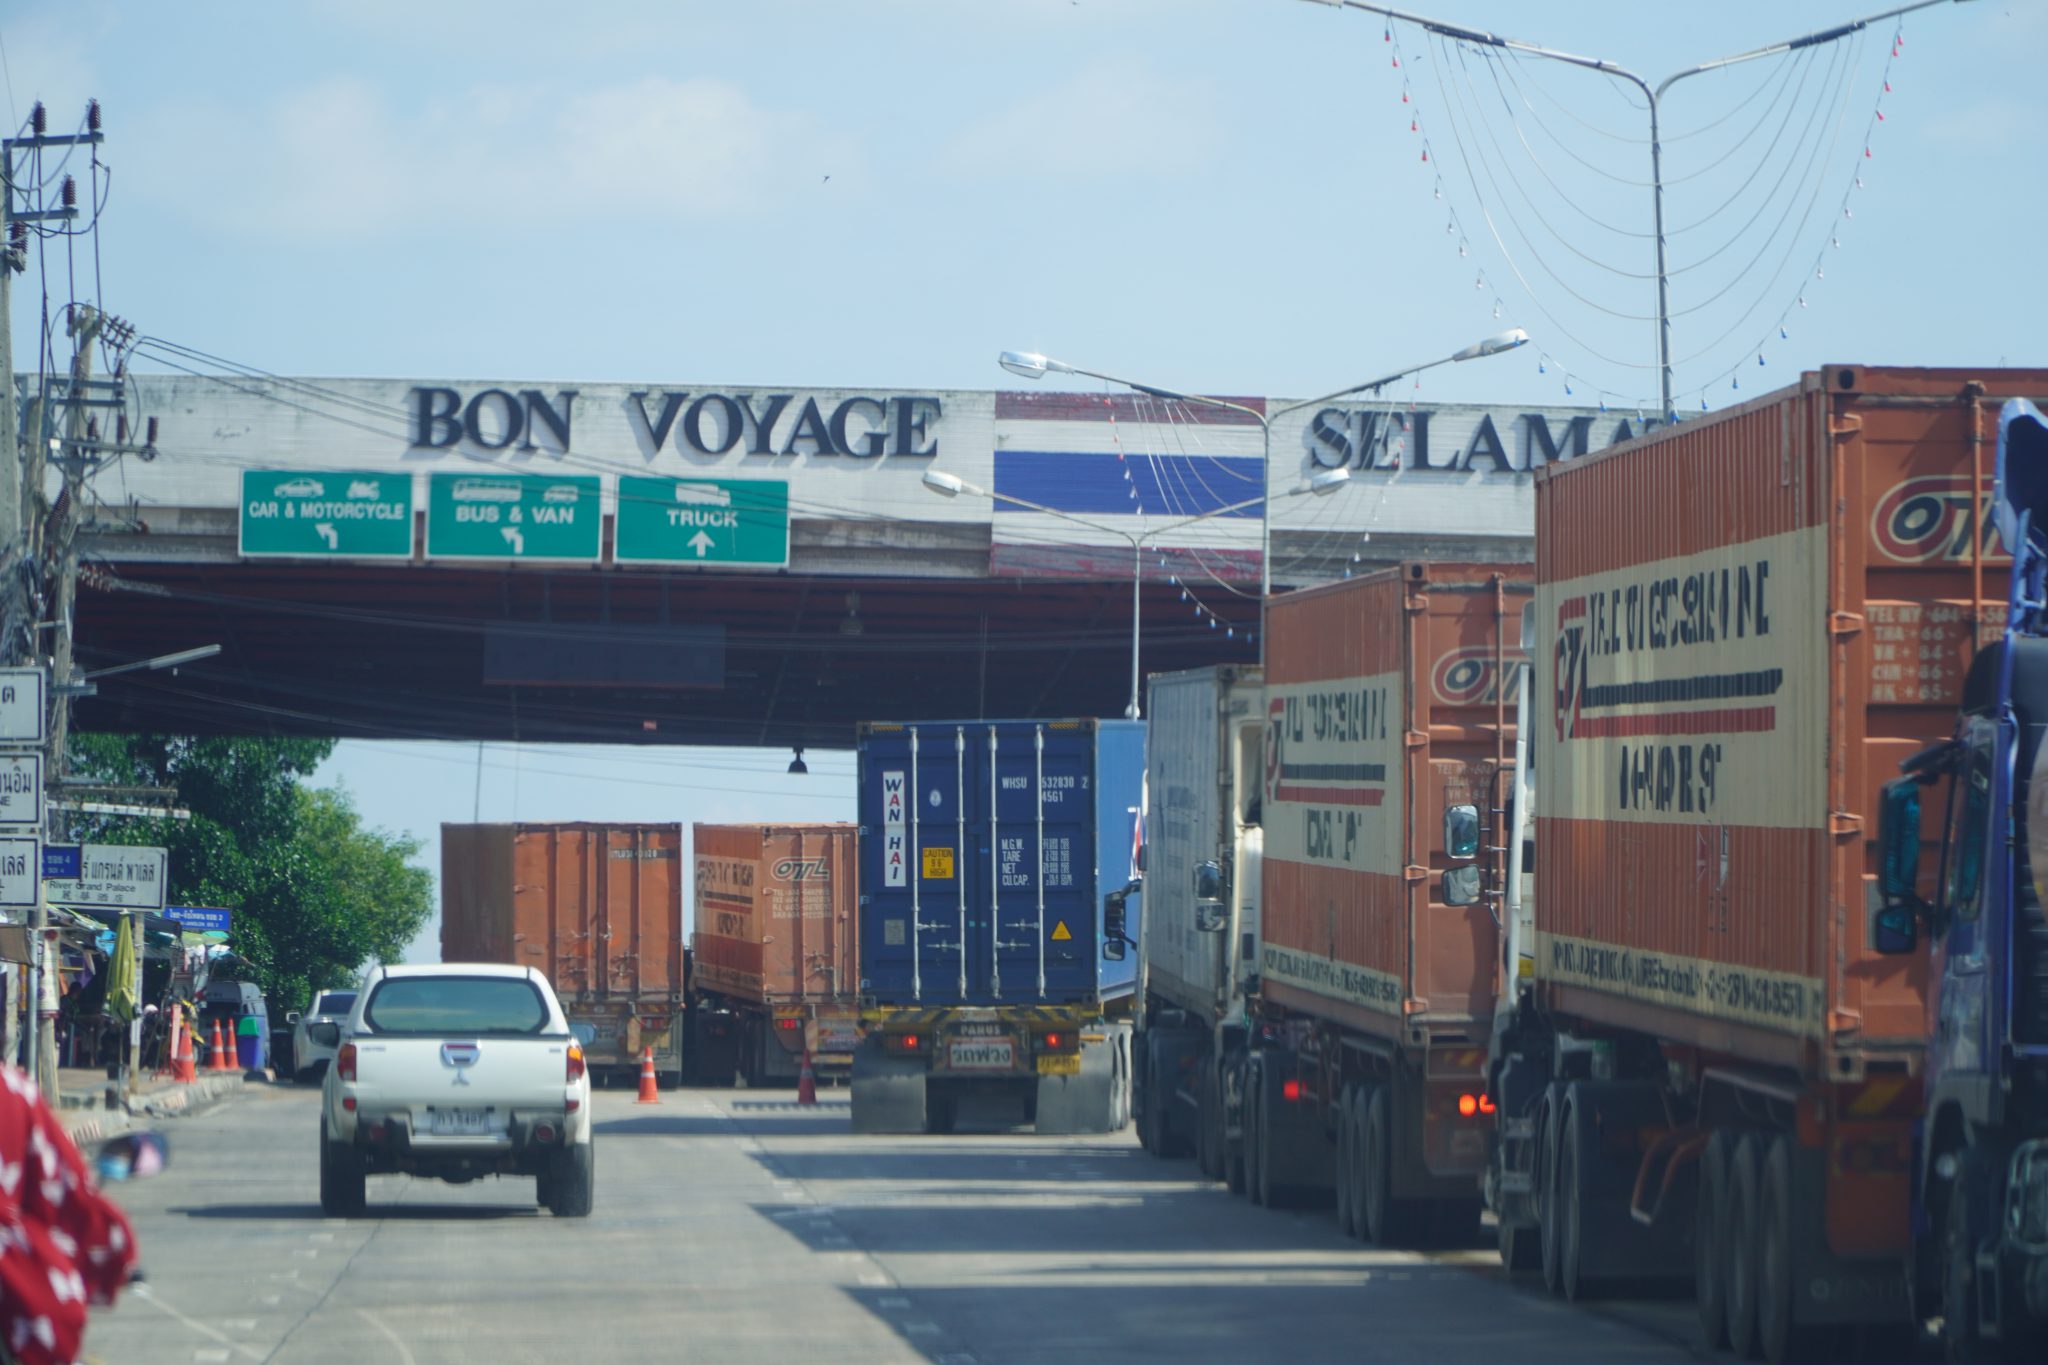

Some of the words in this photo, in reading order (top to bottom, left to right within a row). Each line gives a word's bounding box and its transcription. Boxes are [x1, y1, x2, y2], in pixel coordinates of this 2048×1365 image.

[411, 387, 579, 454] BON
[630, 391, 942, 459] VOYAGE
[1311, 408, 1665, 473] SELAM
[249, 501, 278, 518] CAR
[285, 502, 295, 518] &
[301, 502, 405, 520] MOTORCYCLE
[455, 505, 499, 522] BUS
[509, 506, 522, 523] &
[532, 507, 574, 524] VAN
[667, 509, 738, 528] TRUCK
[1002, 776, 1027, 789] WHSU
[1041, 776, 1075, 789] 532830
[1082, 776, 1089, 789] 2
[885, 778, 902, 822] WAN
[1041, 791, 1063, 802] 45G1
[889, 836, 902, 880] HAI
[1002, 851, 1021, 862] TARE
[1002, 863, 1016, 873] NET
[49, 880, 71, 890] River
[106, 882, 136, 892] Palace
